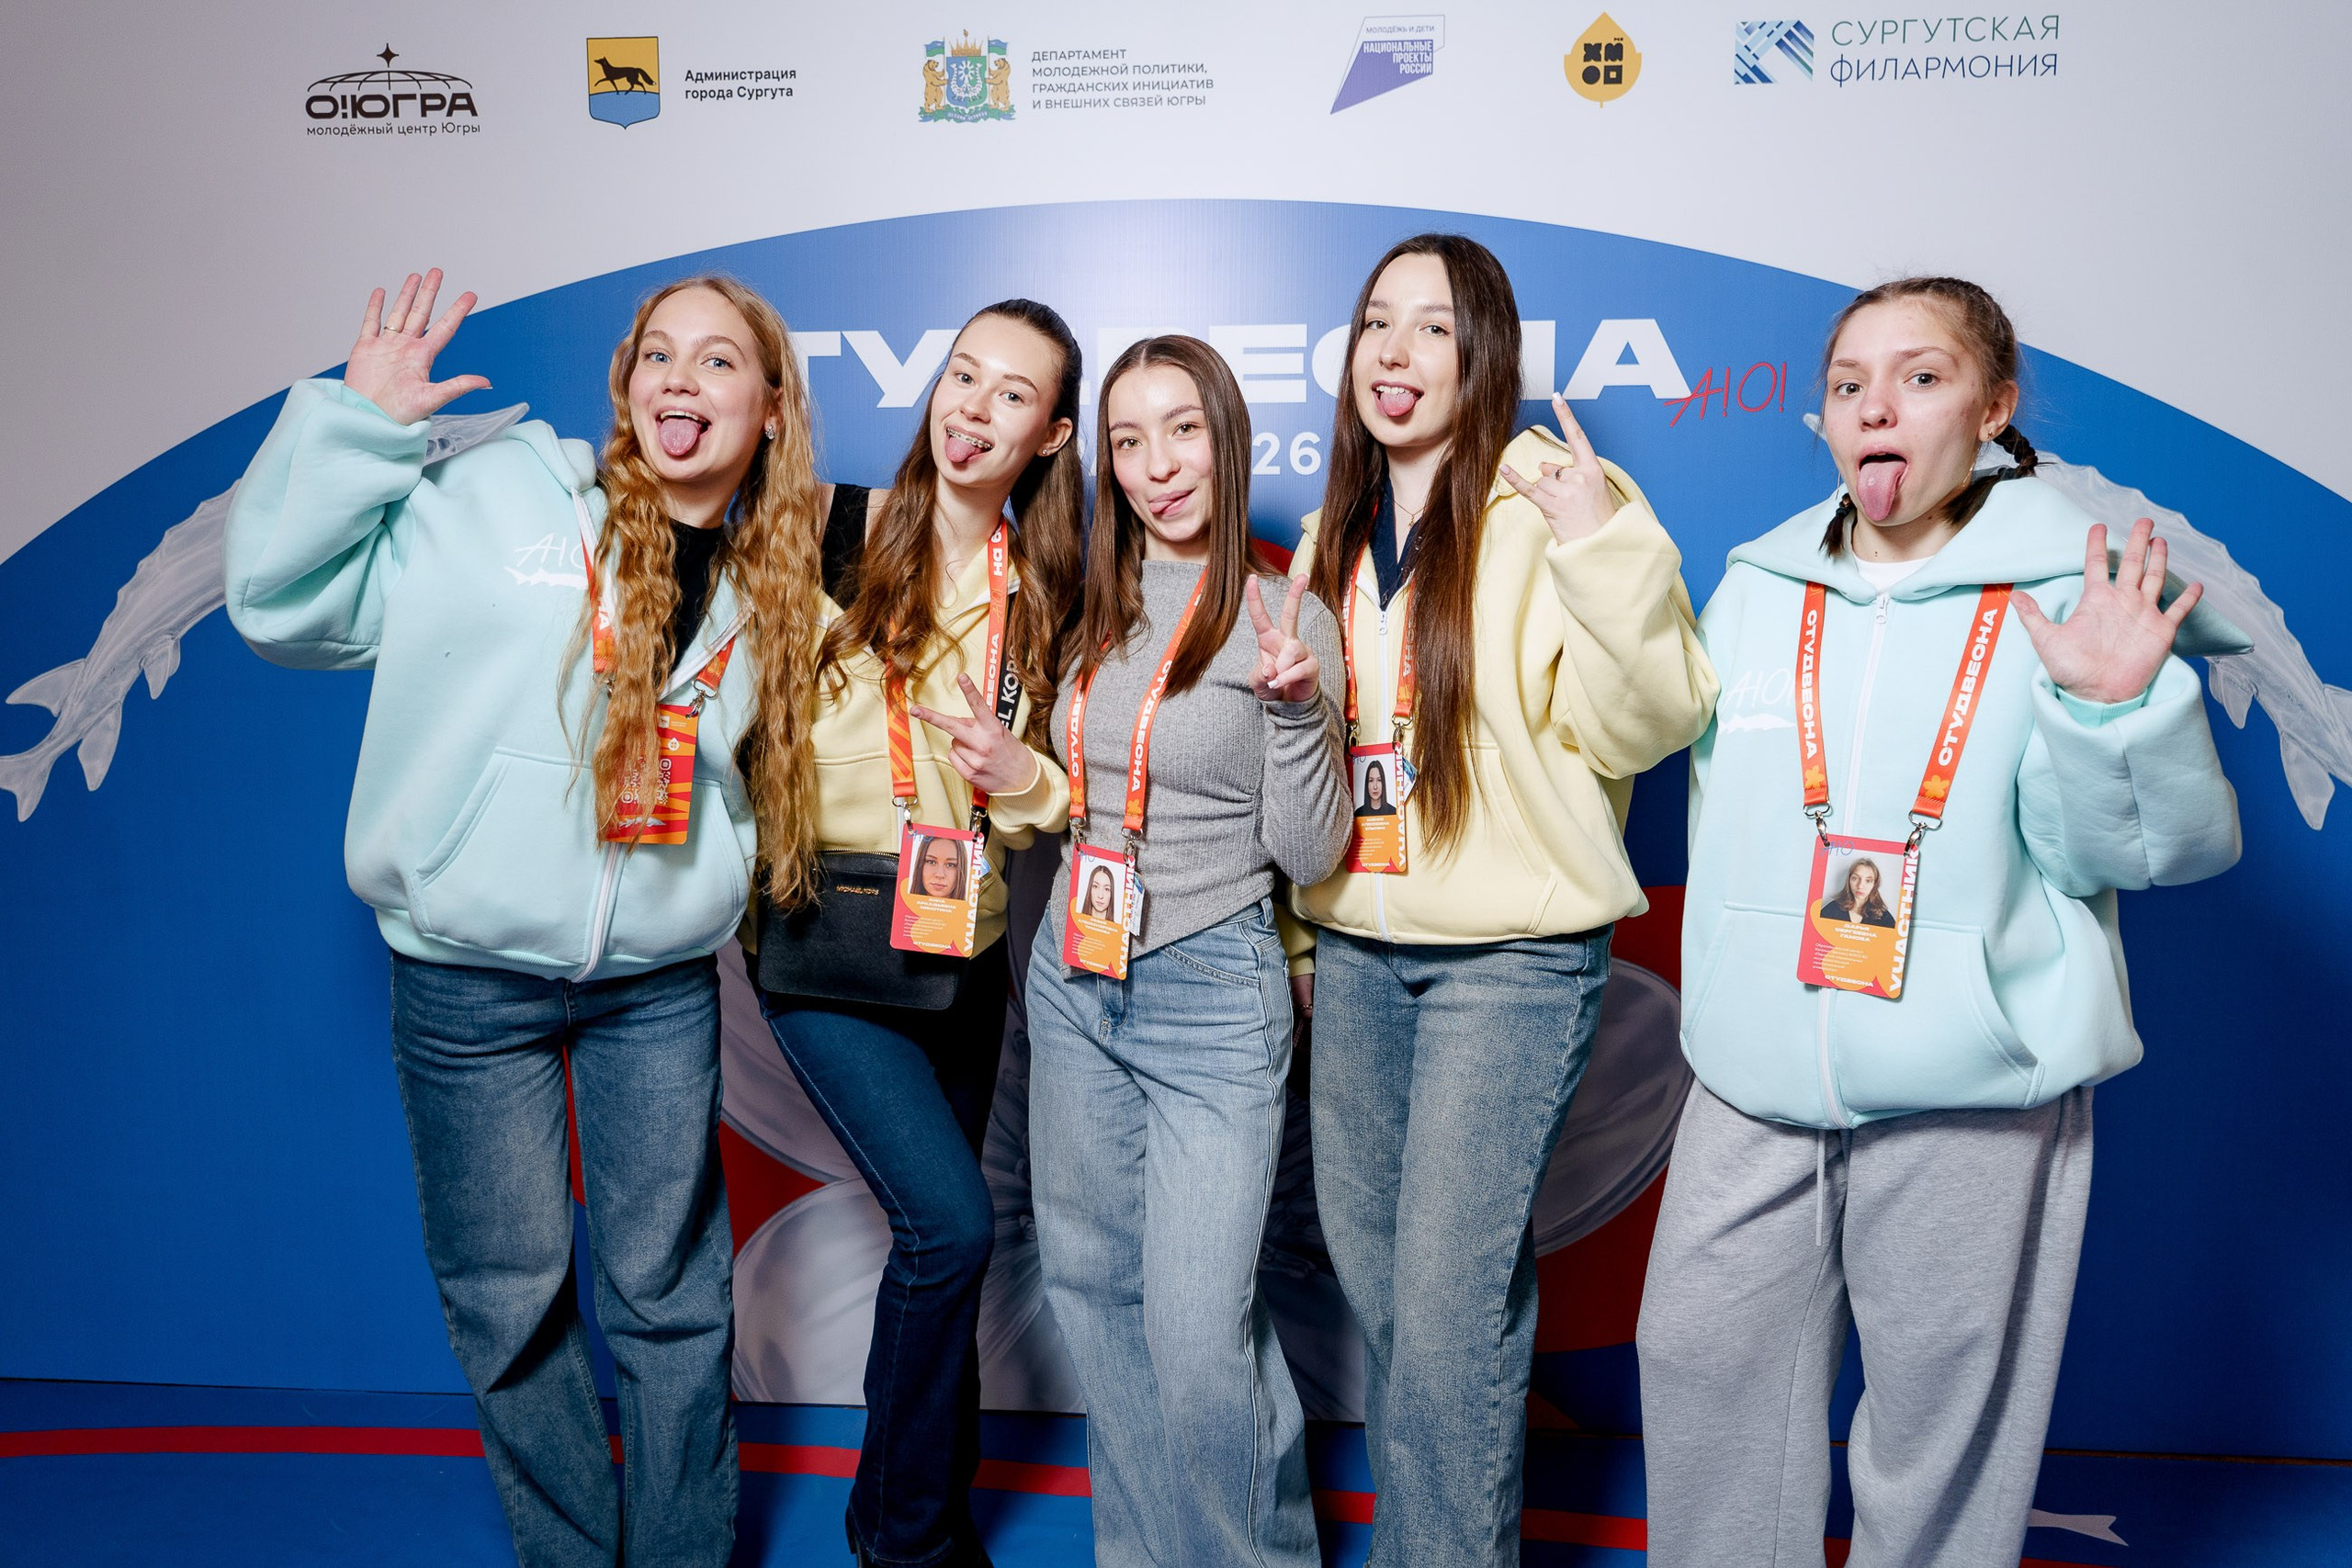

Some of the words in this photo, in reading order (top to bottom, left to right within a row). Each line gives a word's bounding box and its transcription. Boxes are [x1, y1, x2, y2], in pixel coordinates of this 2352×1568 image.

[1831, 14, 2060, 46] СУРГУТСКАЯ
[1363, 40, 1433, 54] НАЦИОНАЛЬНЫЕ
[1031, 49, 1127, 62] ДЕПАРТАМЕНТ
[1392, 52, 1433, 64] ПРОЕКТЫ
[684, 67, 797, 83] Администрация
[1032, 63, 1129, 78] МОЛОДЕЖНОЙ
[1132, 62, 1208, 75] ПОЛИТИКИ,
[1399, 62, 1433, 74] РОССИИ
[1830, 53, 2058, 88] ФИЛАРМОНИЯ
[684, 87, 733, 101] города
[736, 85, 794, 100] Сургута
[1032, 82, 1129, 96] ГРАЖДАНСКИХ
[1132, 79, 1216, 92] ИНИЦИАТИВ
[305, 93, 479, 120] О!ЮГРА
[1033, 99, 1042, 109] И
[1045, 97, 1110, 109] ВНЕШНИХ
[1113, 95, 1164, 108] СВЯЗЕЙ
[1166, 96, 1207, 107] ЮГРЫ
[306, 122, 394, 138] молодёжный
[397, 125, 438, 138] центр
[441, 121, 481, 136] Югры
[1888, 846, 1919, 992] УЧАСТНИК
